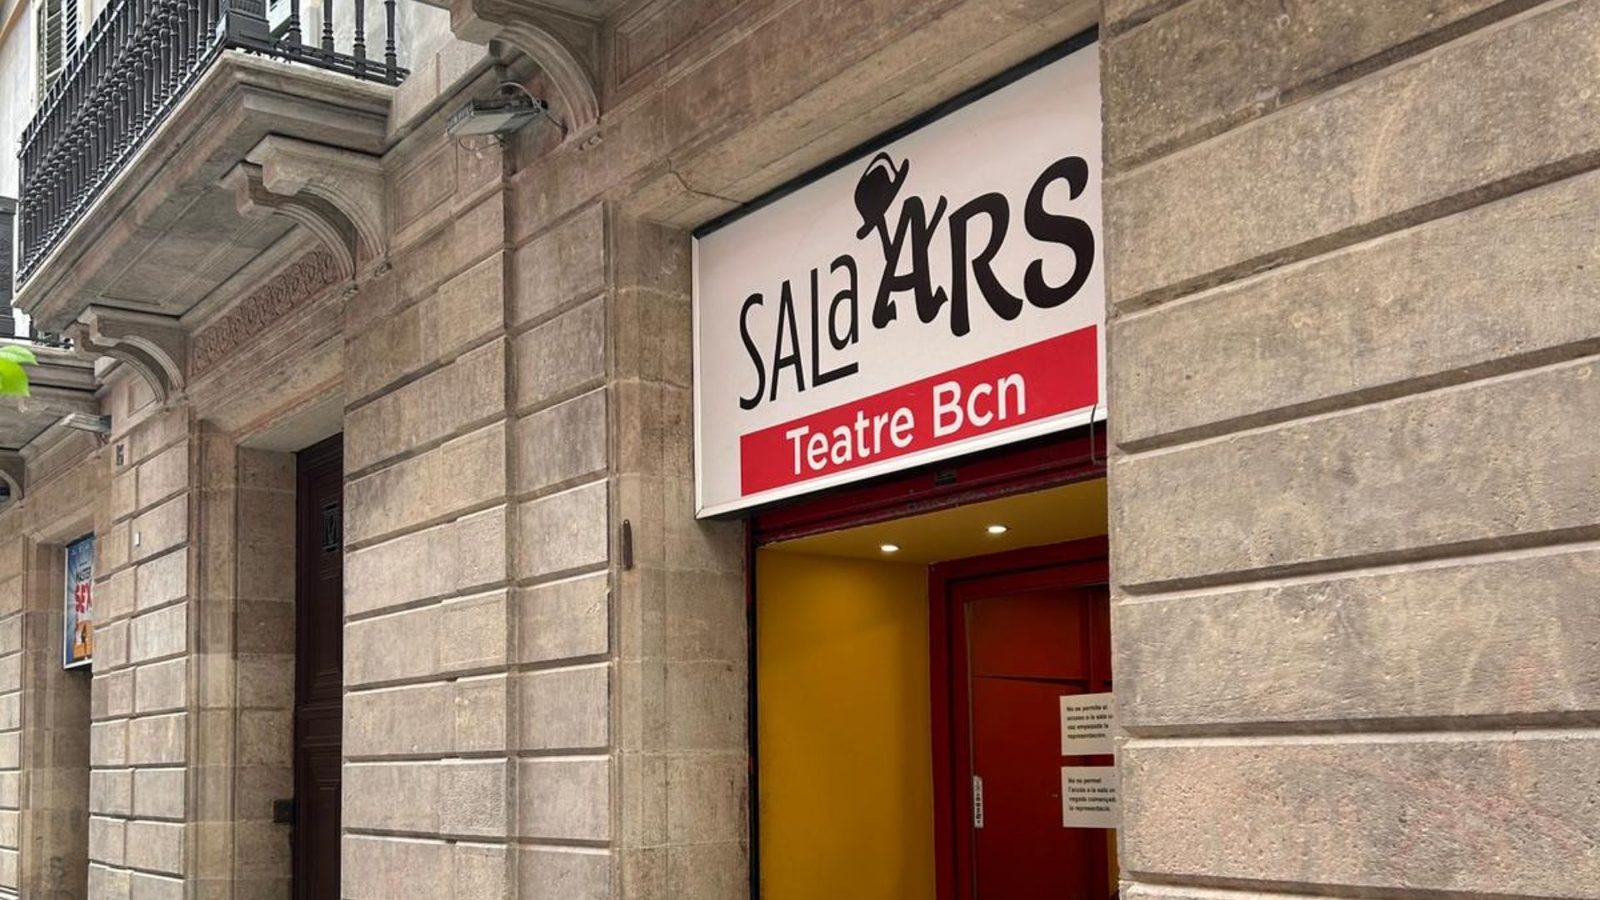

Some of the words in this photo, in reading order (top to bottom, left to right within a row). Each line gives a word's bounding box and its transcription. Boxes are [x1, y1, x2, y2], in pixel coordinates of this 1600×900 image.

[869, 153, 1095, 337] ARS
[786, 404, 915, 476] Teatre
[932, 371, 1027, 438] Bcn
